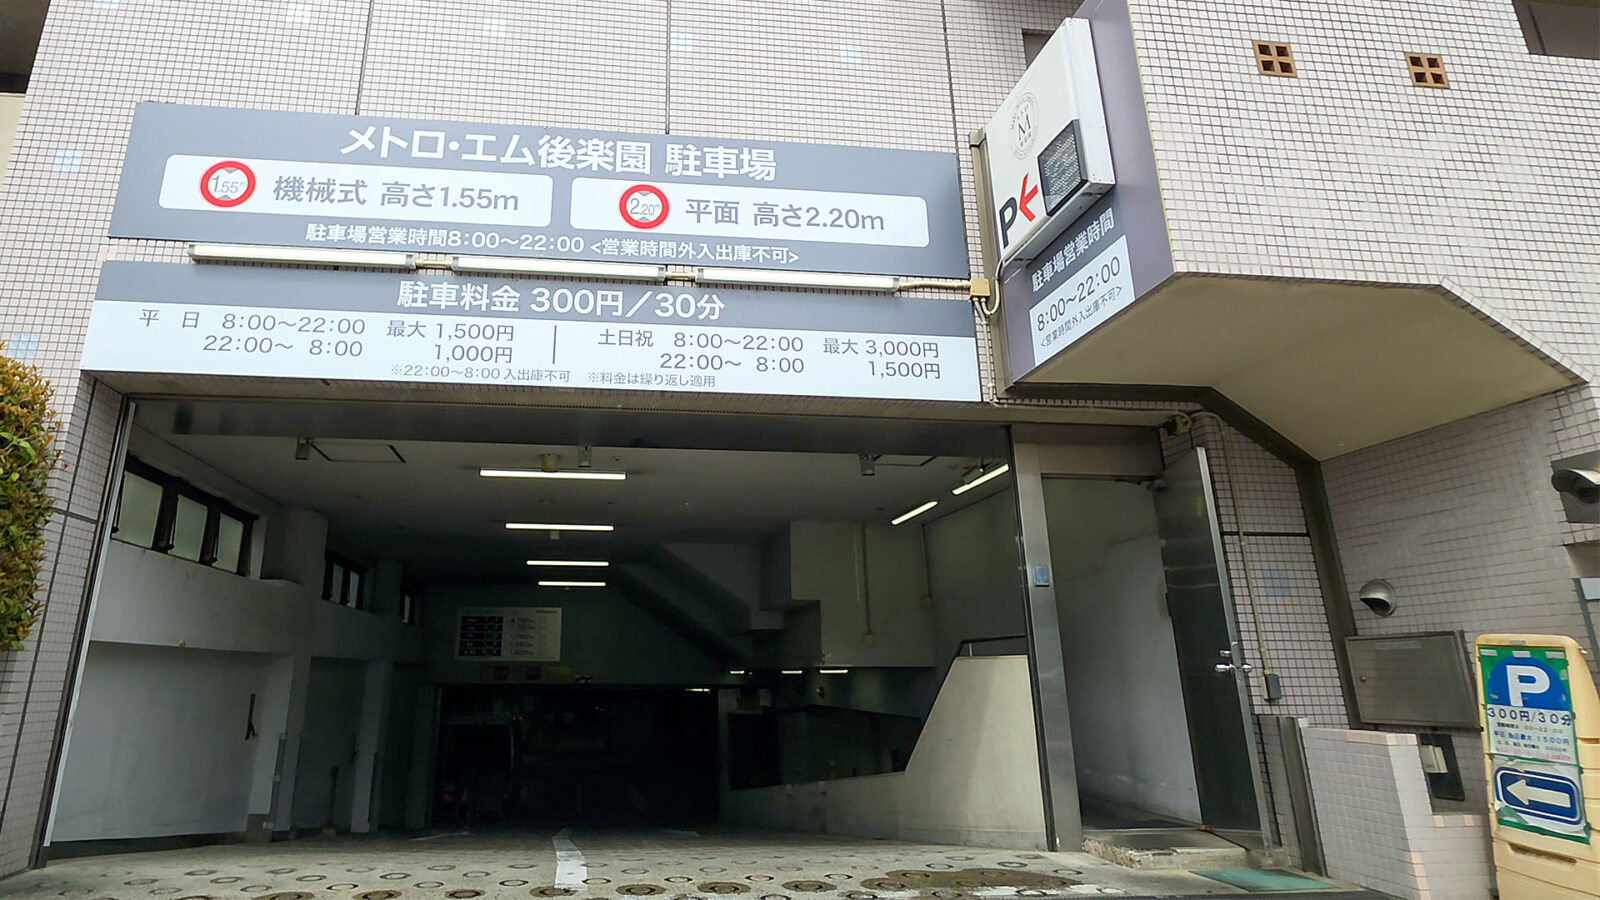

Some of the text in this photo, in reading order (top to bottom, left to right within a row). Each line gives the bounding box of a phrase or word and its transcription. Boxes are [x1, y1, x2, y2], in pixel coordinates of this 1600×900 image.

[340, 125, 777, 182] メトロ・エム後楽園 駐車場
[273, 175, 520, 211] 機械式 高さ1.55m
[685, 199, 885, 231] 平面 高さ2.20m
[999, 197, 1018, 249] P
[1031, 207, 1115, 293] 駐車場営業時間
[397, 280, 520, 312] 駐車料金
[386, 320, 427, 338] 最大
[435, 323, 515, 342] 1,500円
[597, 329, 654, 348] 土日祝
[823, 337, 859, 355] 最大
[865, 340, 939, 359] 3,000円
[433, 344, 513, 364] 1,000円
[868, 360, 941, 380] 1,500円
[503, 368, 571, 384] 入出庫不可
[1506, 664, 1550, 707] P
